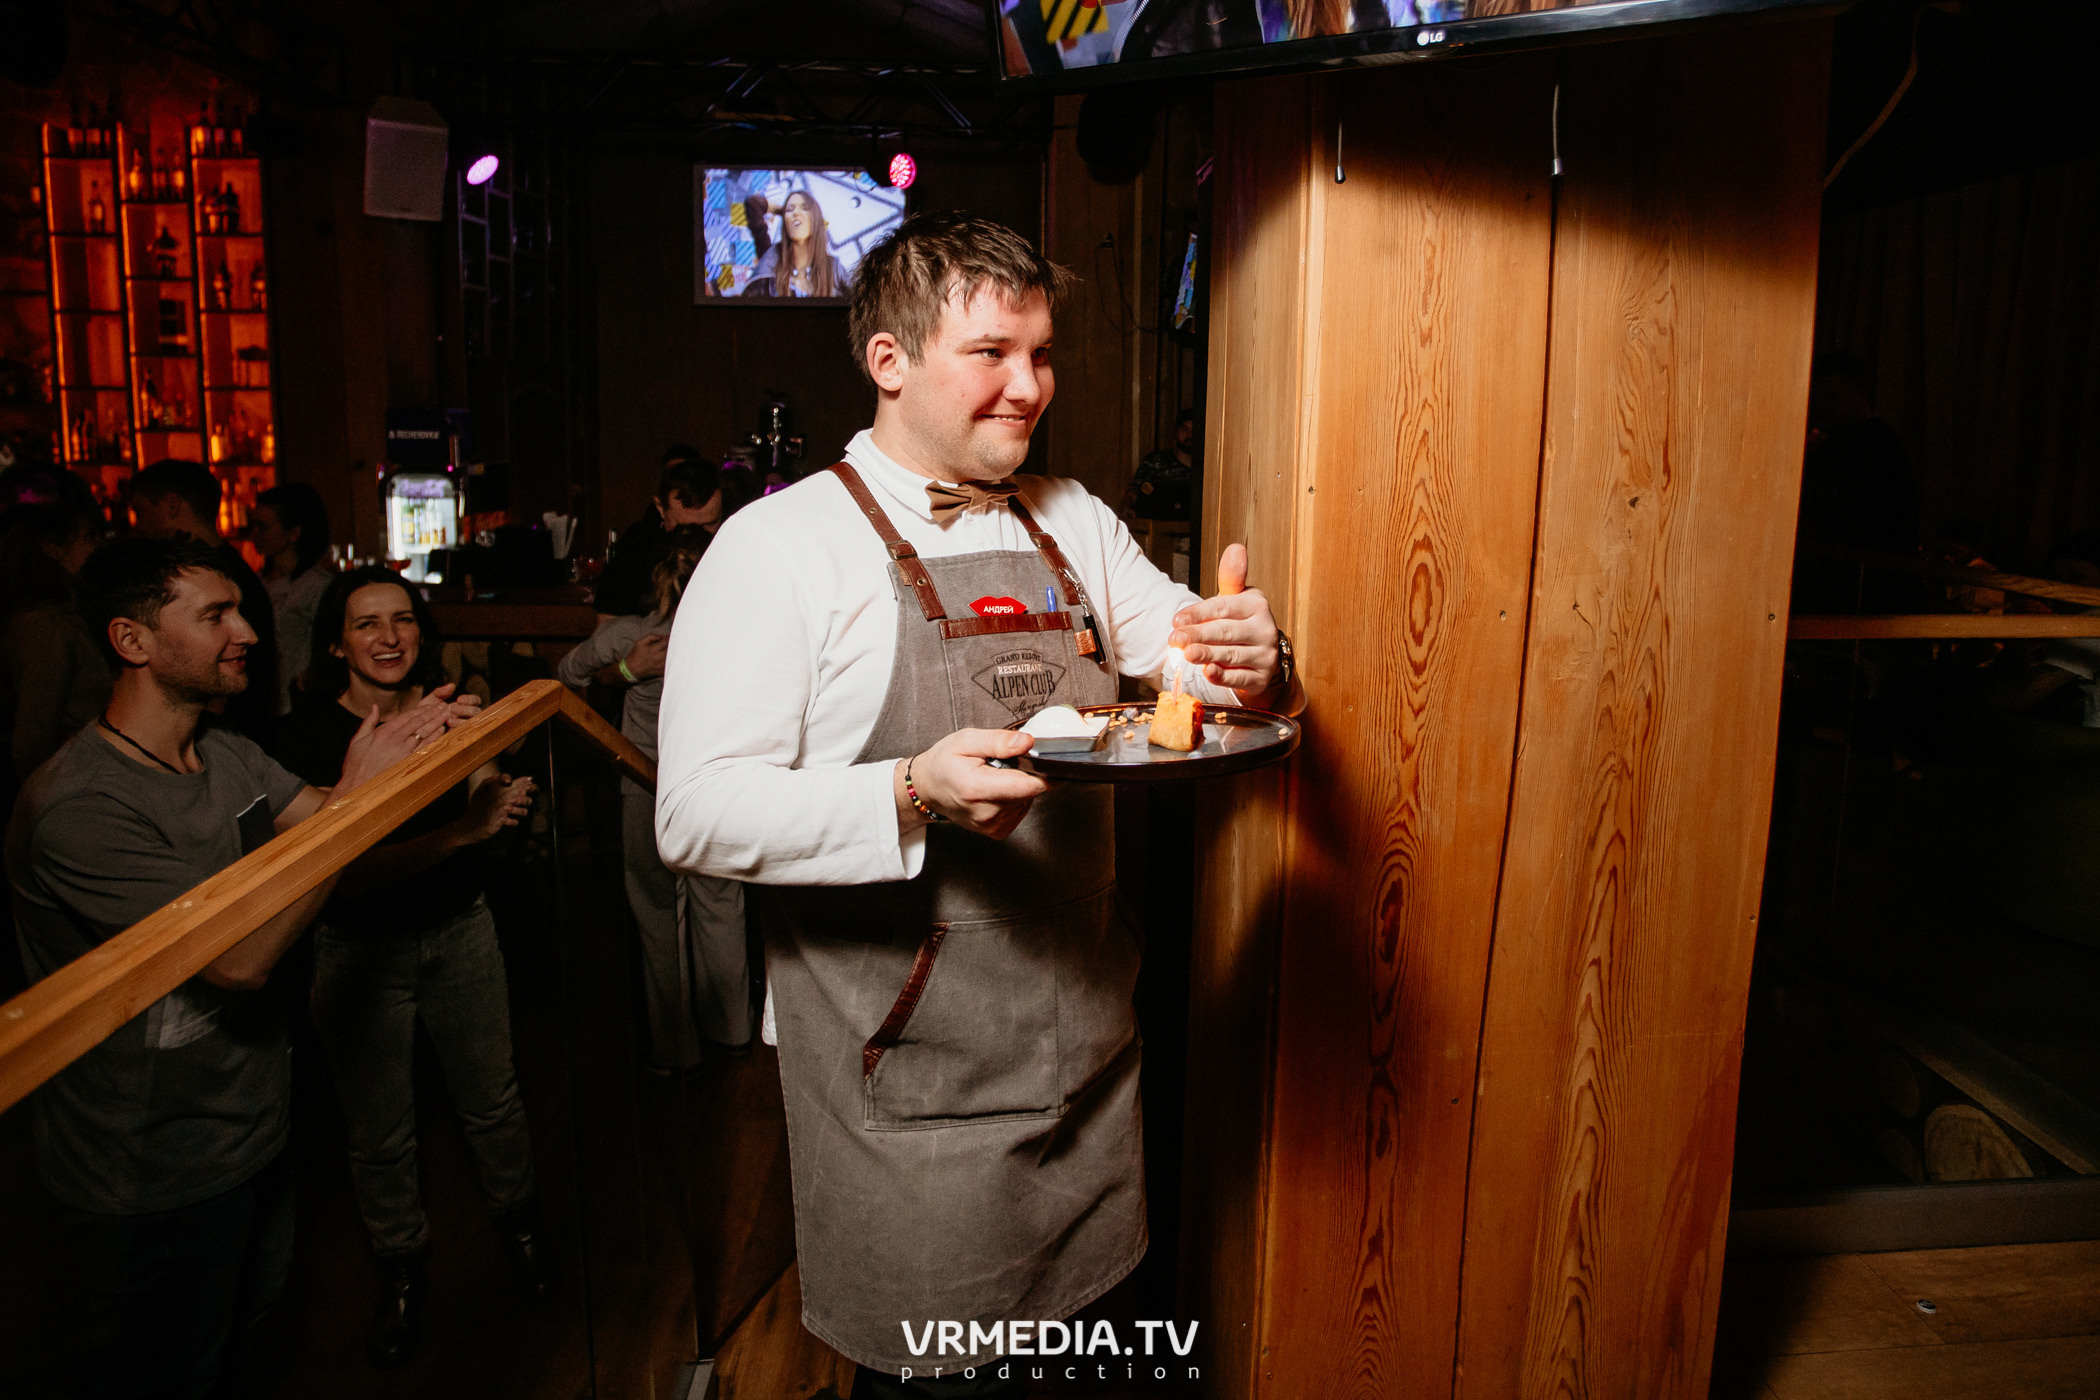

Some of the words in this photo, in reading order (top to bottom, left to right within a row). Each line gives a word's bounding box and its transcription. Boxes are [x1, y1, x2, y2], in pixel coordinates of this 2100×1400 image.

[1430, 32, 1444, 43] LG
[983, 605, 1014, 614] АНДРЕЙ
[995, 653, 1020, 664] GRAND
[997, 664, 1042, 675] RESTAURANT
[992, 674, 1029, 699] ALPEN
[1030, 669, 1056, 697] CLUB
